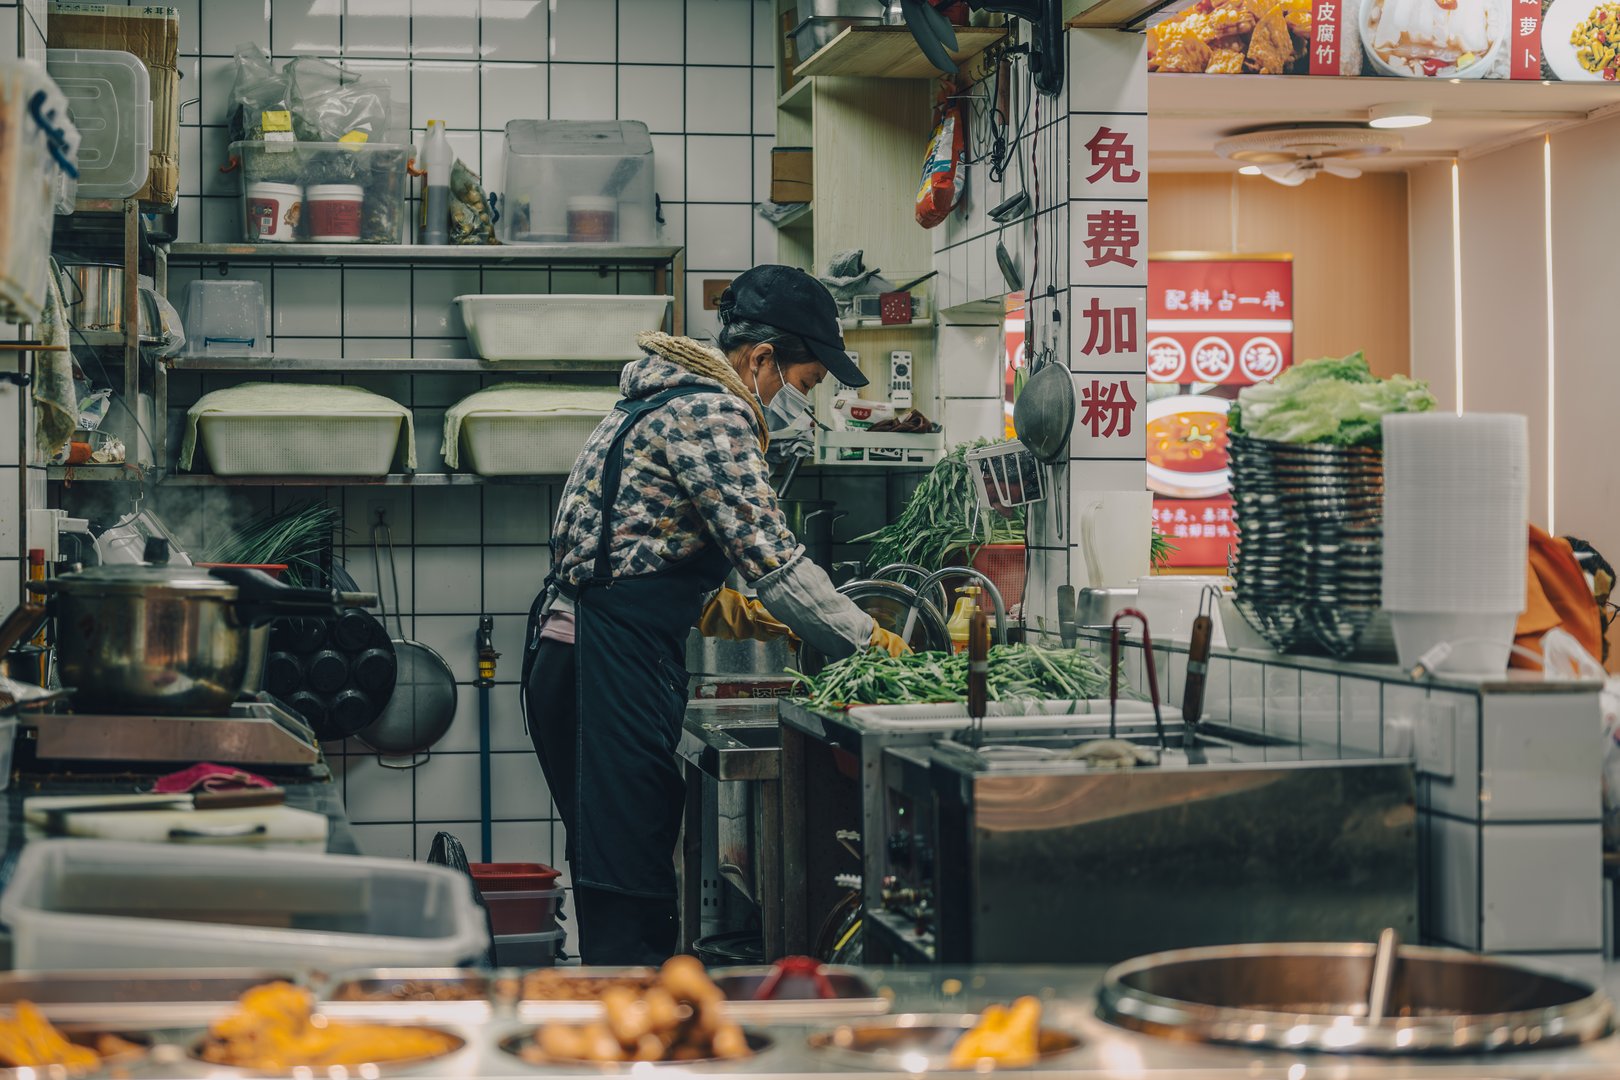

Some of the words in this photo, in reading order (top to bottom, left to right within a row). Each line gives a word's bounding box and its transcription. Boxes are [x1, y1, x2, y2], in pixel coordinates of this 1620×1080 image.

[1316, 2, 1336, 65] 皮腐竹
[1519, 0, 1539, 69] 萝卜
[1080, 126, 1141, 438] 免费加粉
[1165, 289, 1285, 312] 配料占一半
